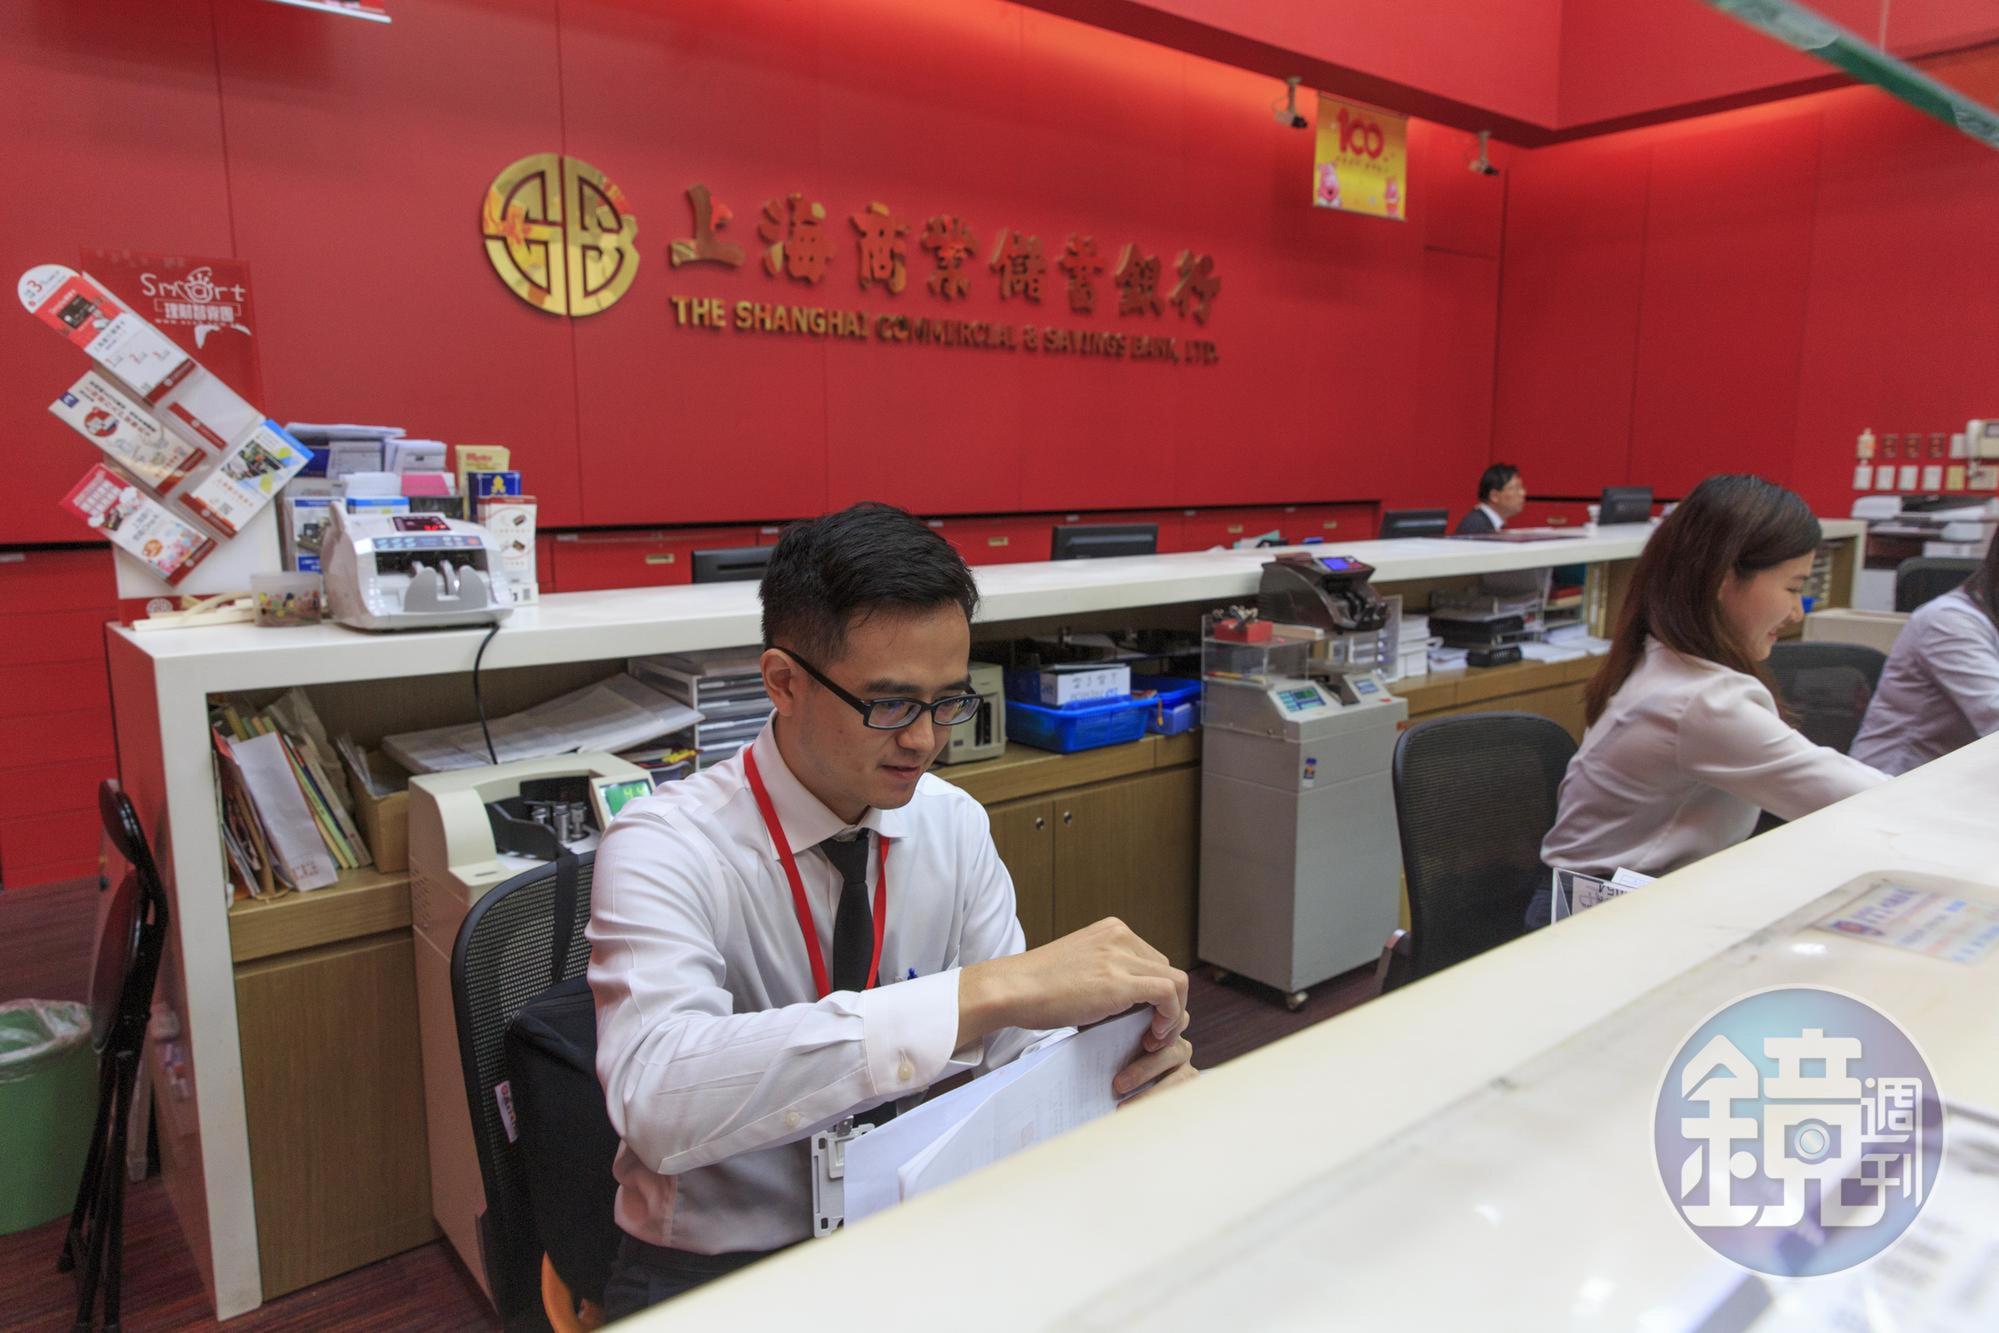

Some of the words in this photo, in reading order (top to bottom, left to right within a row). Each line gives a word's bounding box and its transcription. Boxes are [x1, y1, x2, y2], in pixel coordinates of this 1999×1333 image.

[1337, 107, 1385, 159] 100
[670, 183, 1222, 325] 上海商業儲蓄銀行
[670, 295, 728, 328] THE
[734, 300, 870, 338] SHANGHAI
[874, 314, 1017, 350] COMMERCIAL
[1023, 324, 1039, 351] &
[1043, 326, 1128, 358] SAVINGS
